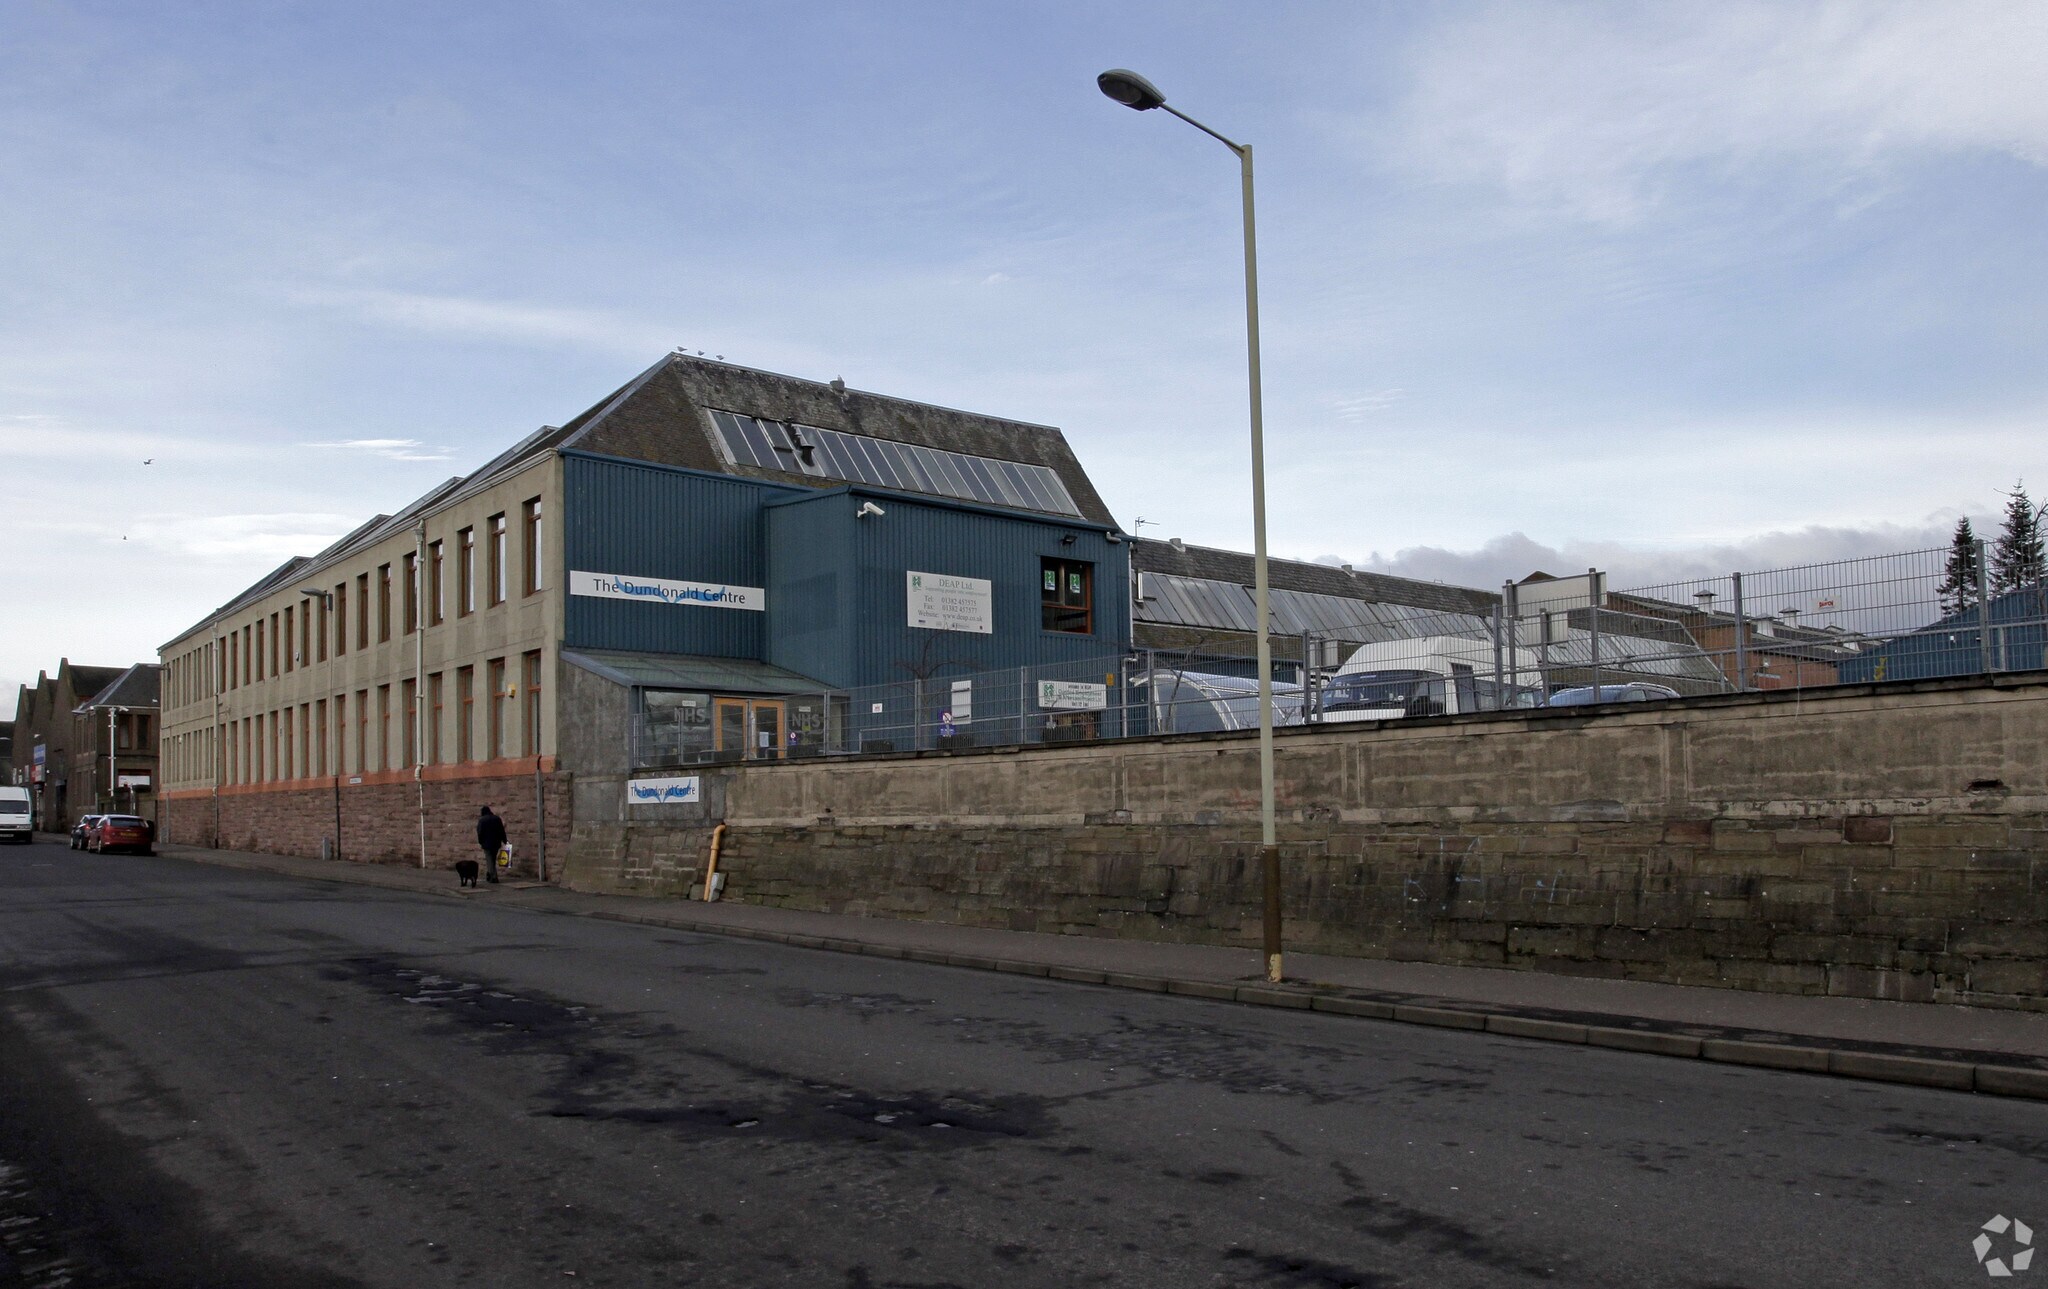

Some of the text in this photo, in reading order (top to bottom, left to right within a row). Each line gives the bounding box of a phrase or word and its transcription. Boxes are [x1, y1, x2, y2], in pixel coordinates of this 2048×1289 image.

[593, 578, 746, 604] The Dundonald Centre
[939, 579, 974, 590] DEAP Ltd.
[674, 707, 706, 723] NHS
[792, 713, 821, 729] NHS
[630, 784, 641, 797] The
[675, 784, 696, 796] Centre
